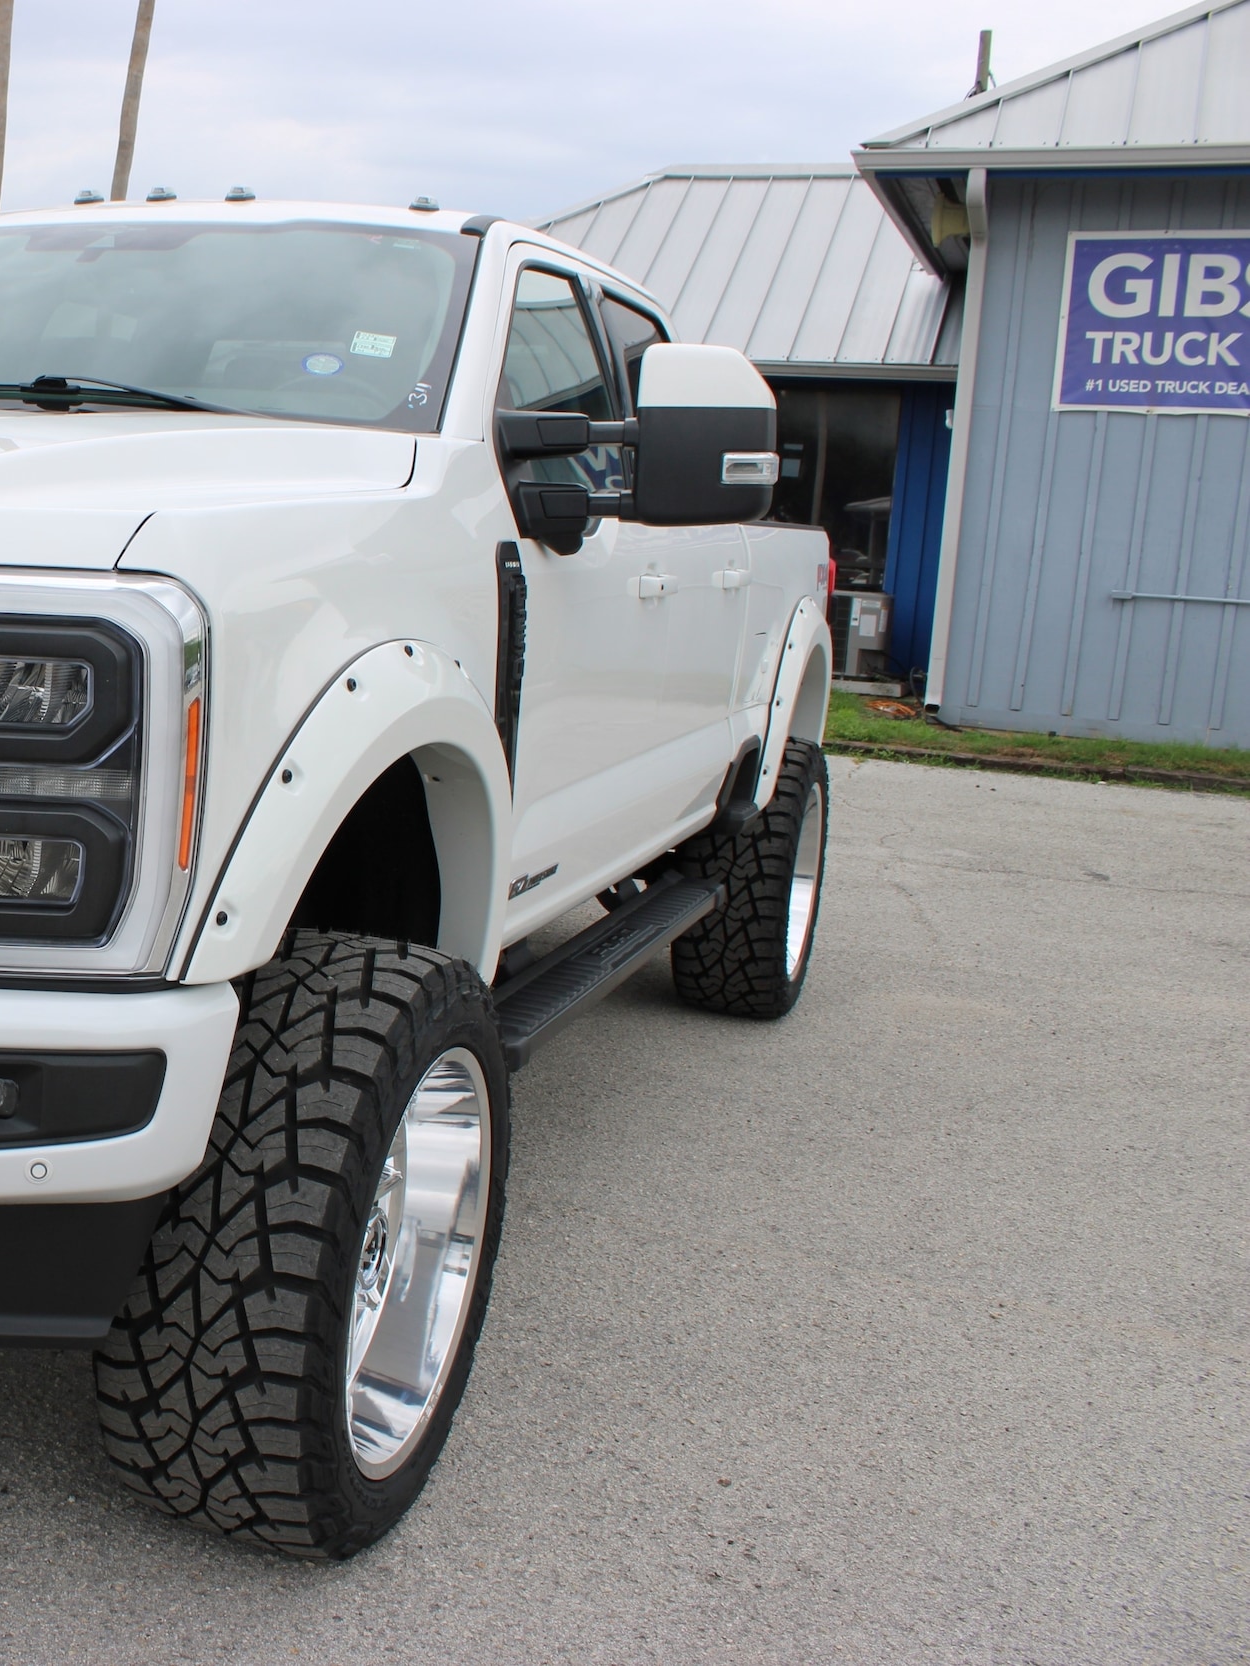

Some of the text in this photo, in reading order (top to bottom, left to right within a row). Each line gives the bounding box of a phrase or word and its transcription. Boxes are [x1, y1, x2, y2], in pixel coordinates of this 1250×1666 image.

[1088, 252, 1250, 319] GIB
[1085, 331, 1243, 366] TRUCK
[1085, 379, 1103, 392] #1
[1108, 379, 1151, 393] USED
[1155, 380, 1211, 394] TRUCK
